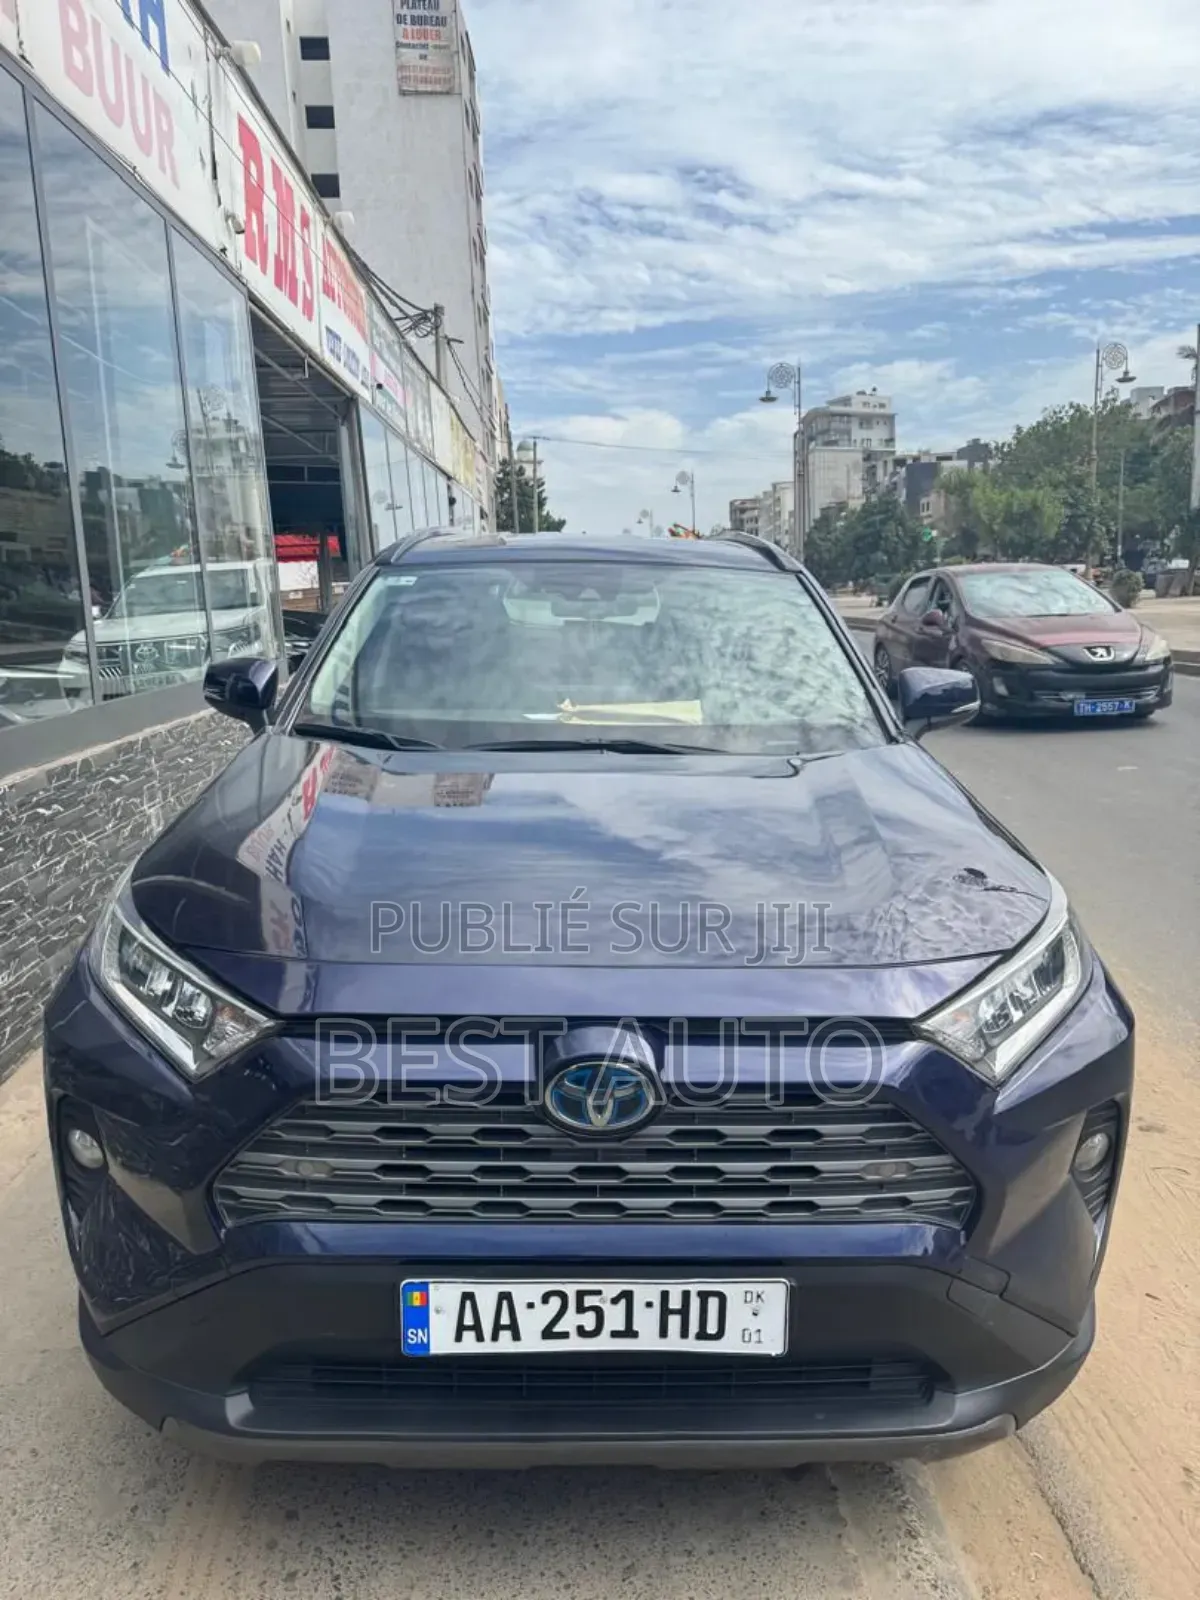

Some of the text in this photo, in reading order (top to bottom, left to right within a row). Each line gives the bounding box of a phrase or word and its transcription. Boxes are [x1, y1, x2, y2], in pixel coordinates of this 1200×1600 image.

[58, 0, 180, 190] BUUR
[744, 1290, 765, 1304] DK
[407, 1328, 428, 1344] SN
